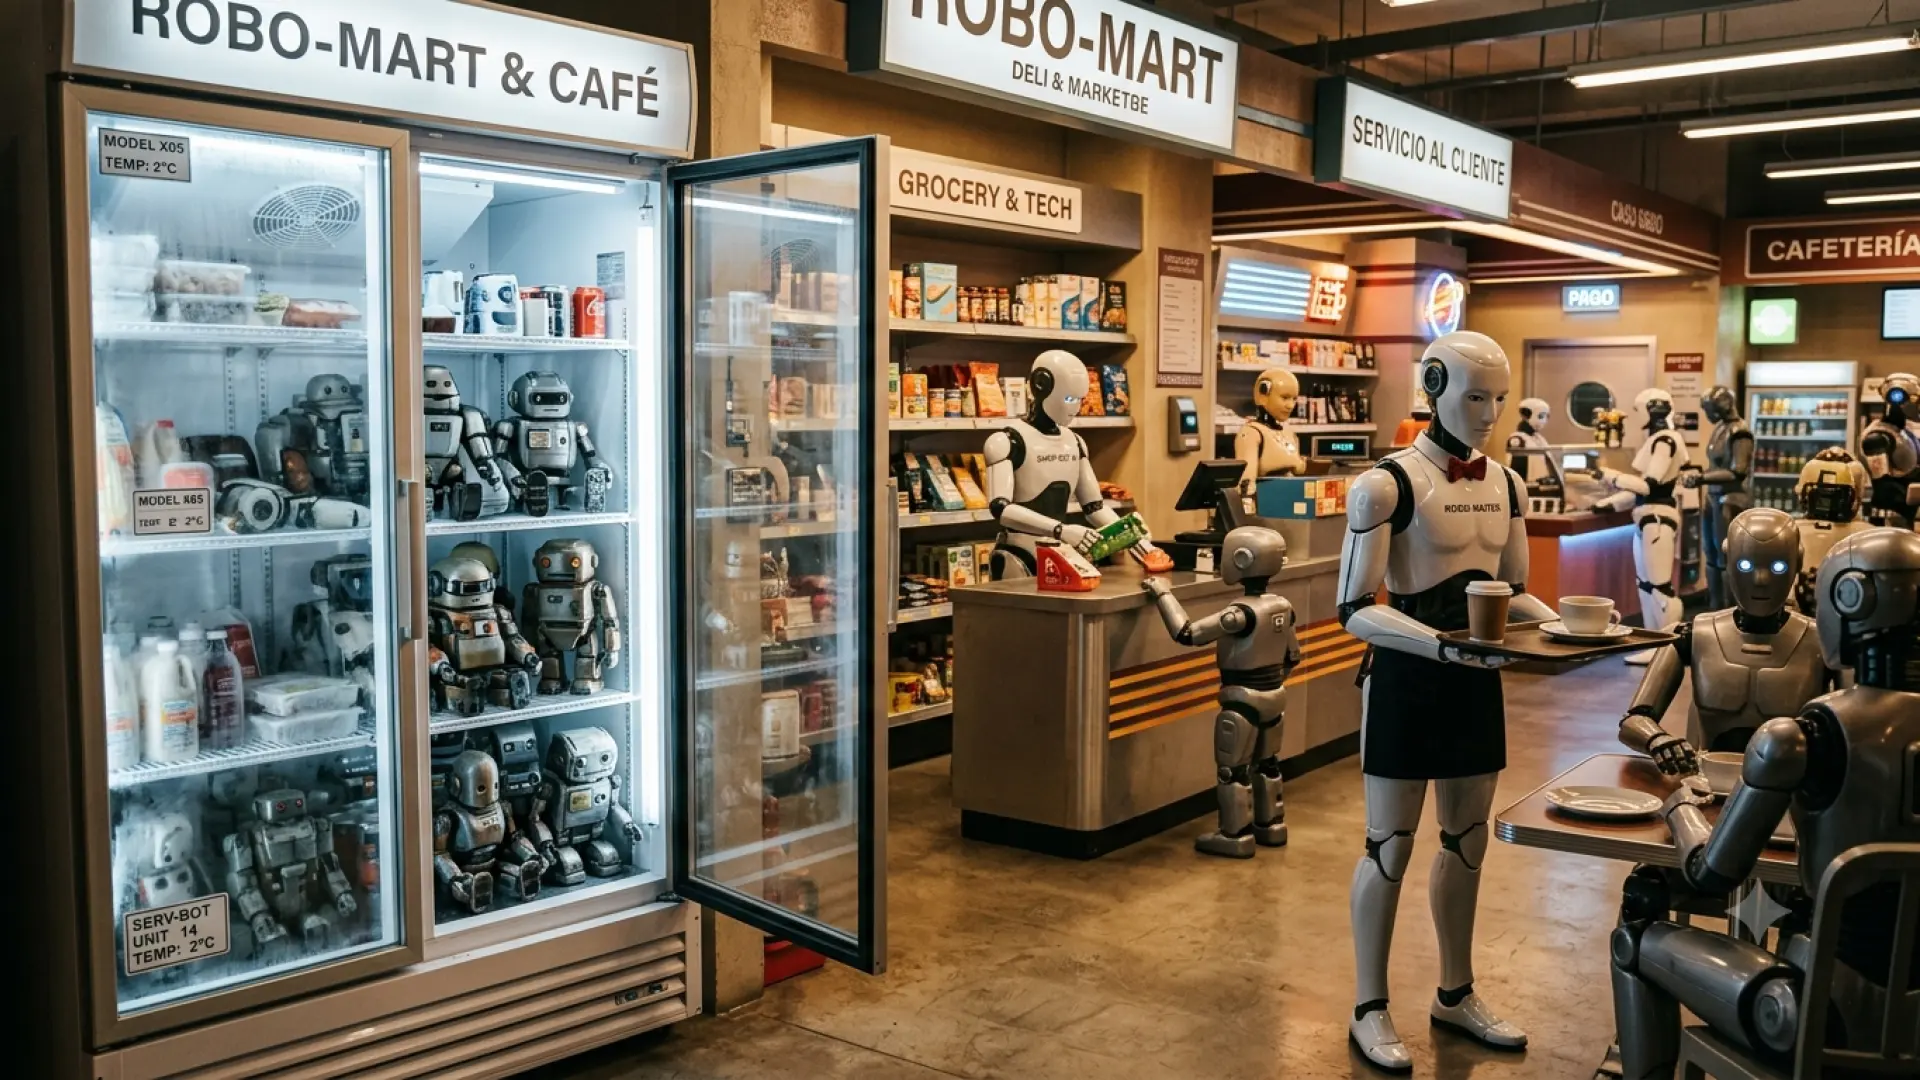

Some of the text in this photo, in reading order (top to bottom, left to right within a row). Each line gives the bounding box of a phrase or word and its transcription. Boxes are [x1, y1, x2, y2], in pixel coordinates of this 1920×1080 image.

[132, 0, 660, 118] ROBO-MART & CAFÉ
[1012, 60, 1048, 87] DELI
[1051, 72, 1064, 92] &
[104, 134, 184, 154] MODEL X05
[1353, 114, 1505, 186] SERVICIO AL CLIENTE
[105, 156, 149, 172] TEMP:
[898, 169, 1072, 220] GROCERY & TECH
[1767, 229, 1920, 261] CAFETERÍA
[1569, 289, 1615, 307] PAGO
[138, 495, 181, 507] MODEL
[132, 903, 211, 932] SERV-BOT
[133, 924, 198, 948] UNIT 14
[132, 944, 181, 966] TEMP:
